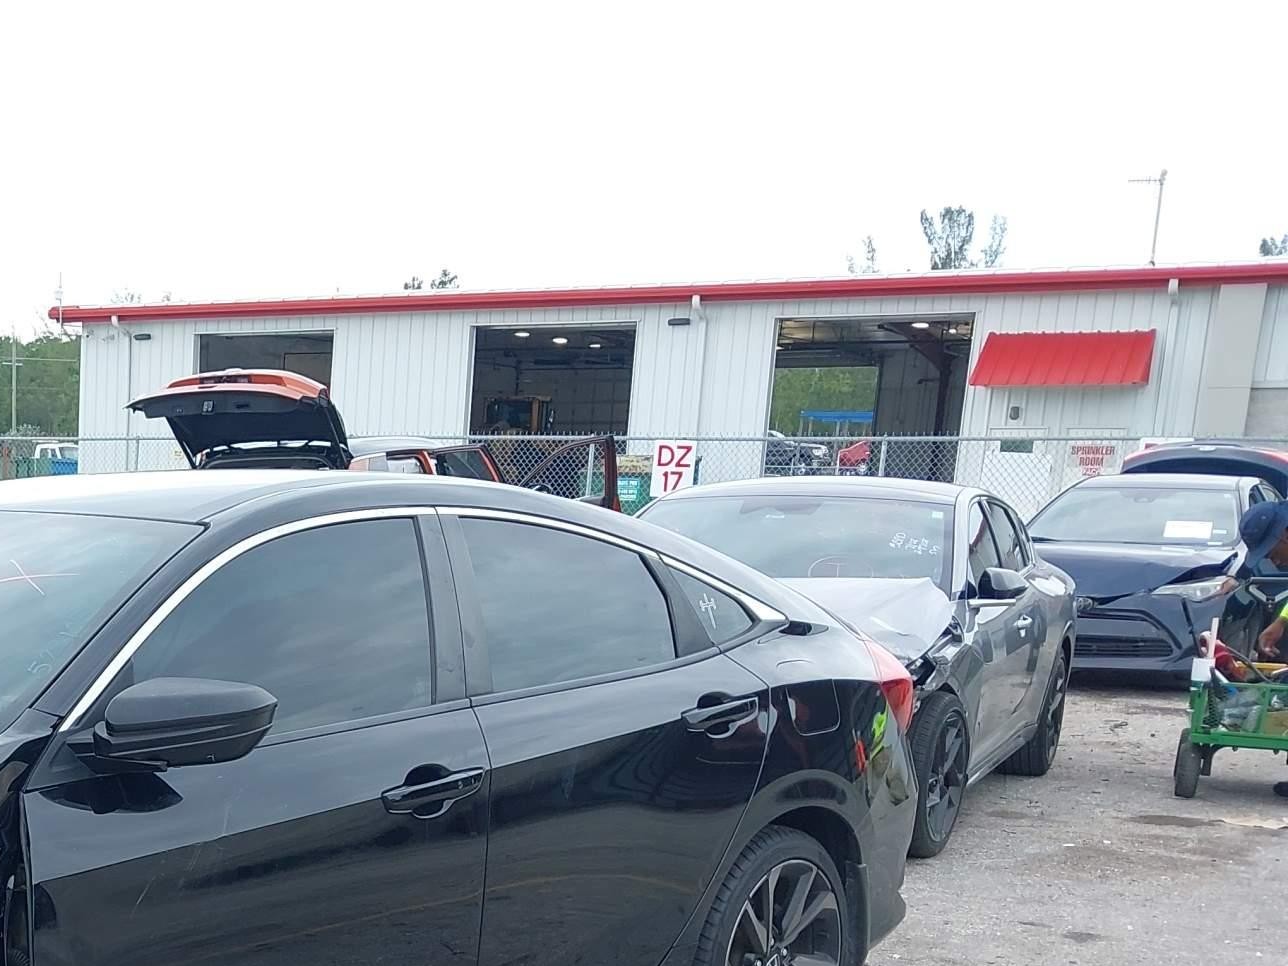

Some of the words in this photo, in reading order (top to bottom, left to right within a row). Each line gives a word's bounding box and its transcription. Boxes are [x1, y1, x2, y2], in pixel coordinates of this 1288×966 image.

[657, 445, 692, 467] DZ
[1071, 446, 1115, 455] SPRINKLER
[1079, 456, 1104, 467] ROOM
[662, 471, 683, 492] 17
